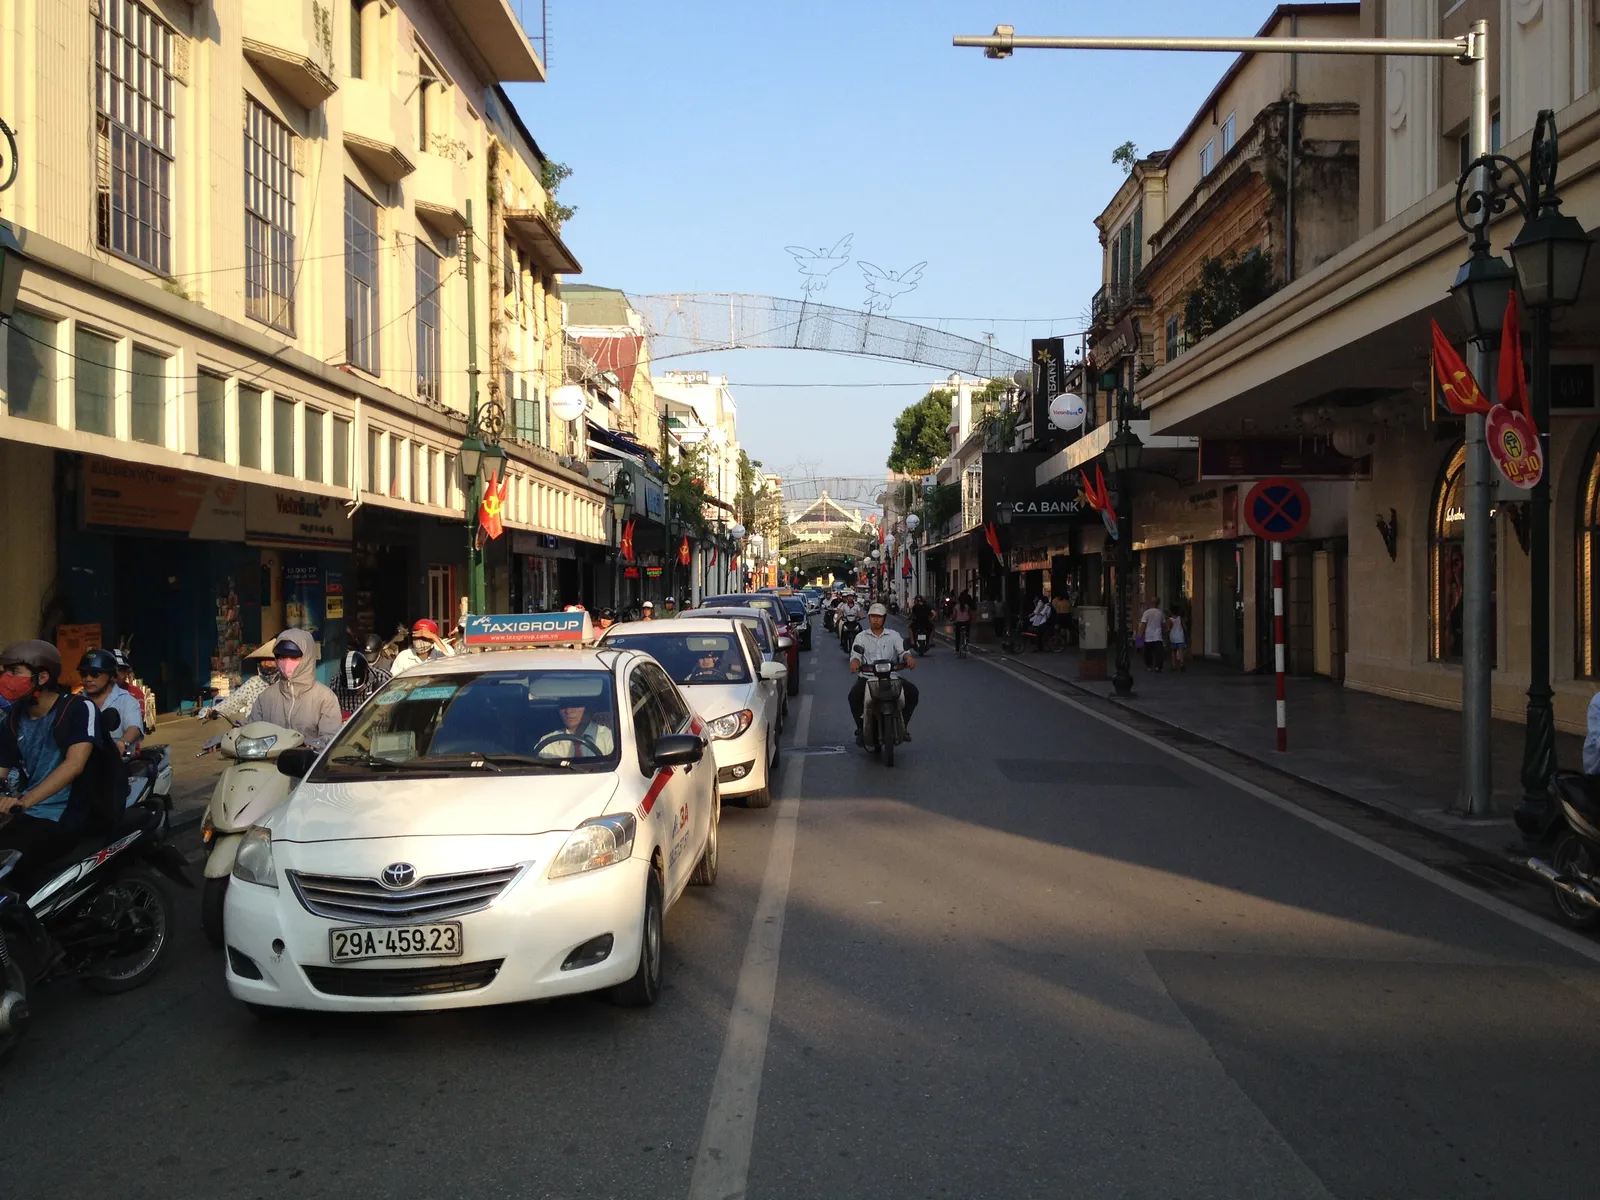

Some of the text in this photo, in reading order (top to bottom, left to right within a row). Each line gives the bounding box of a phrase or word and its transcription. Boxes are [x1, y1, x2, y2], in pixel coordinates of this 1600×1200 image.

[1048, 358, 1057, 391] BANK
[1027, 501, 1038, 513] A
[1041, 501, 1080, 513] BANK
[482, 620, 580, 633] TAXIGROUP
[490, 633, 559, 641] www.taxigroup.com.vn
[679, 802, 689, 830] 3A
[335, 928, 456, 957] 29A-459.23
